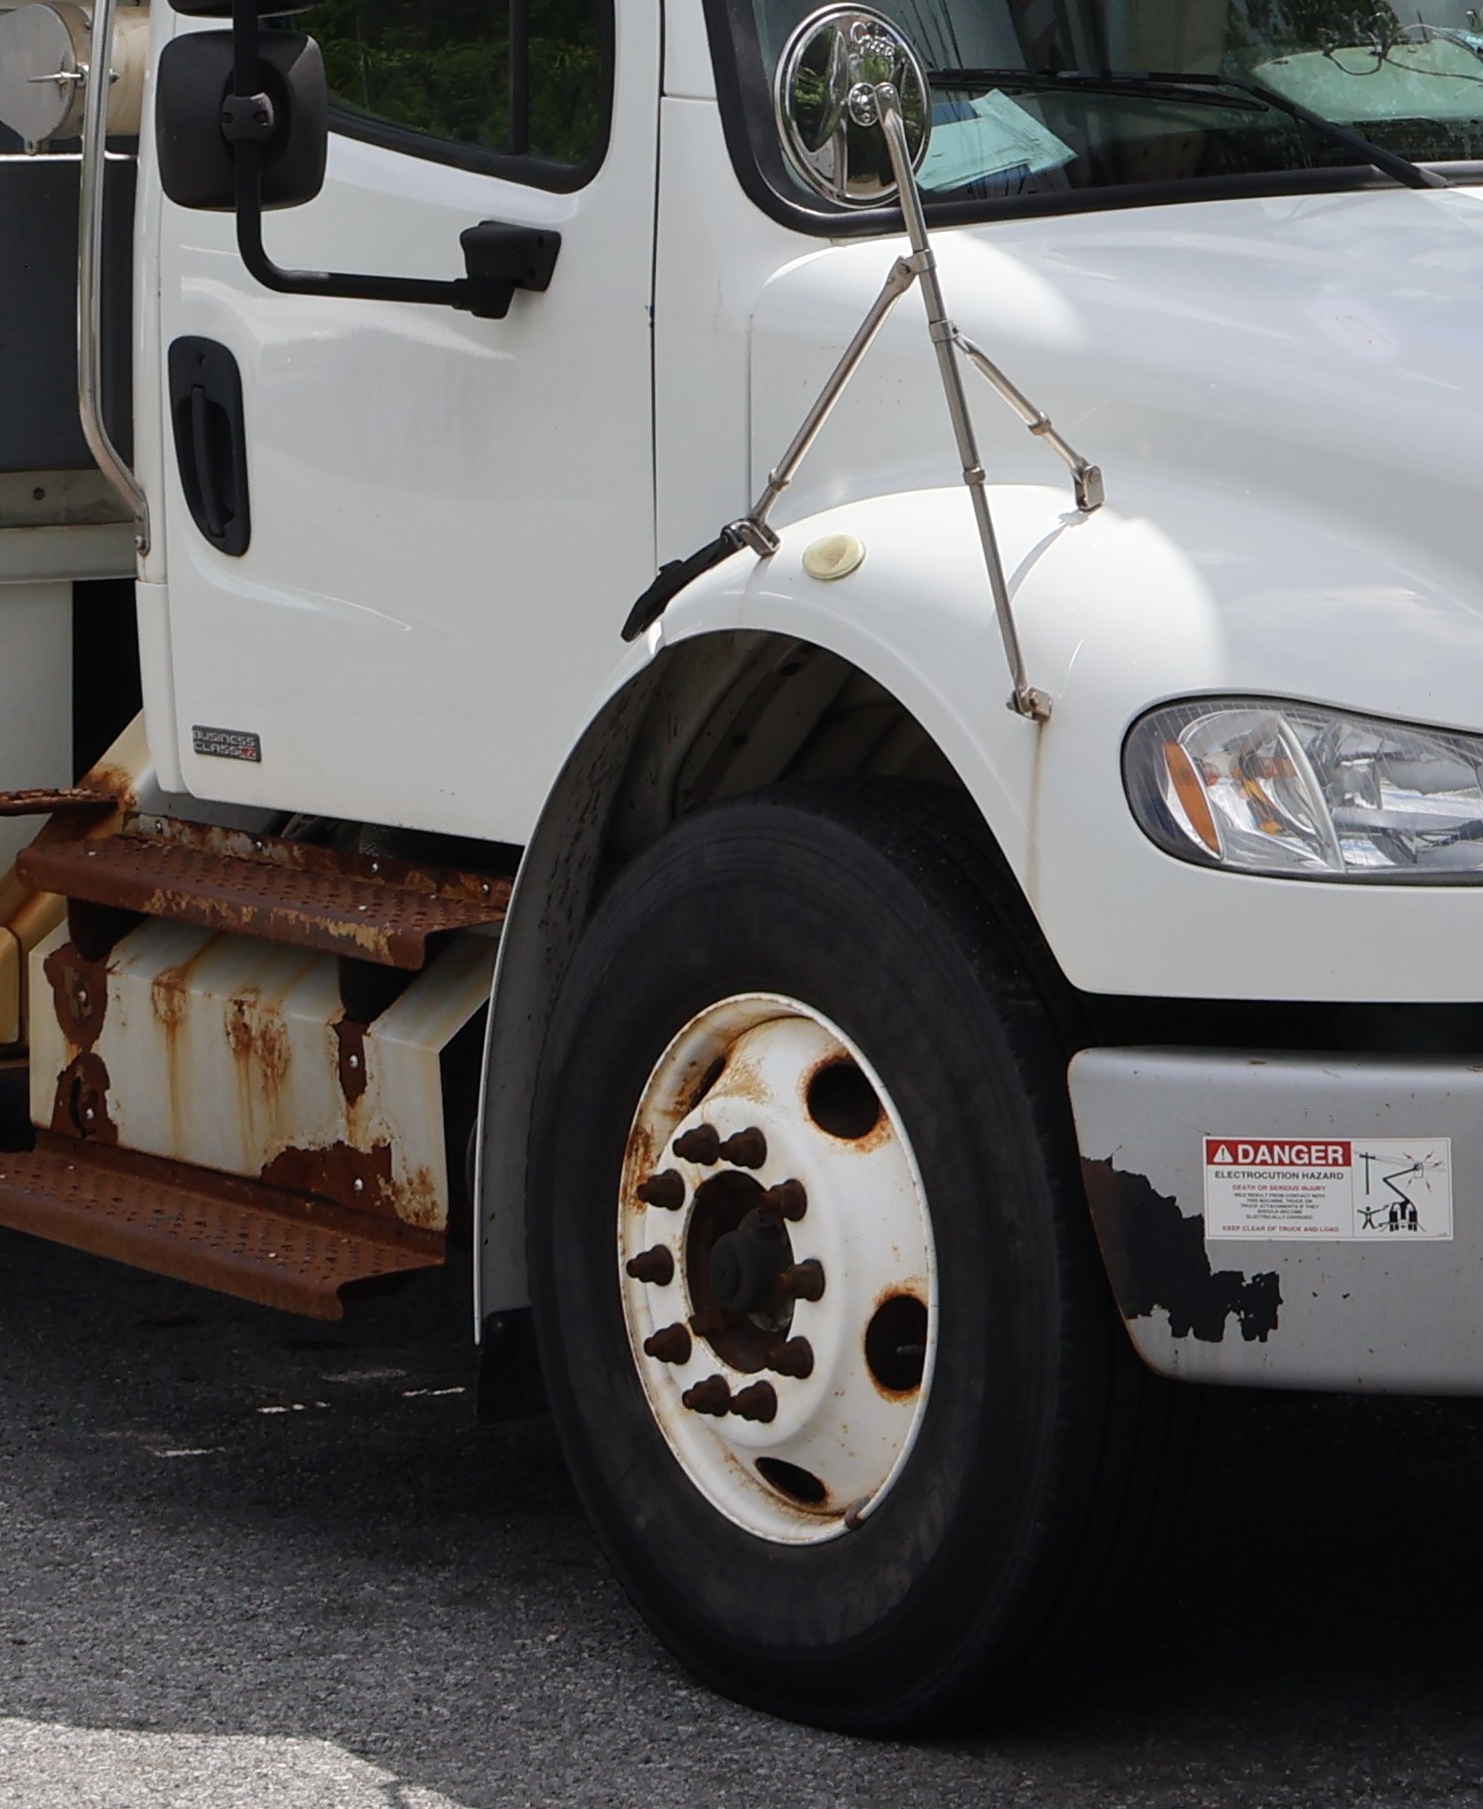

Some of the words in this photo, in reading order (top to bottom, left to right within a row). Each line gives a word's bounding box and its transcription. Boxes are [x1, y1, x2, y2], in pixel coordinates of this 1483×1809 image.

[1238, 1144, 1344, 1165] DANGER
[1215, 1170, 1299, 1180] ELECTROCUTION
[1302, 1171, 1344, 1180] HAZARD
